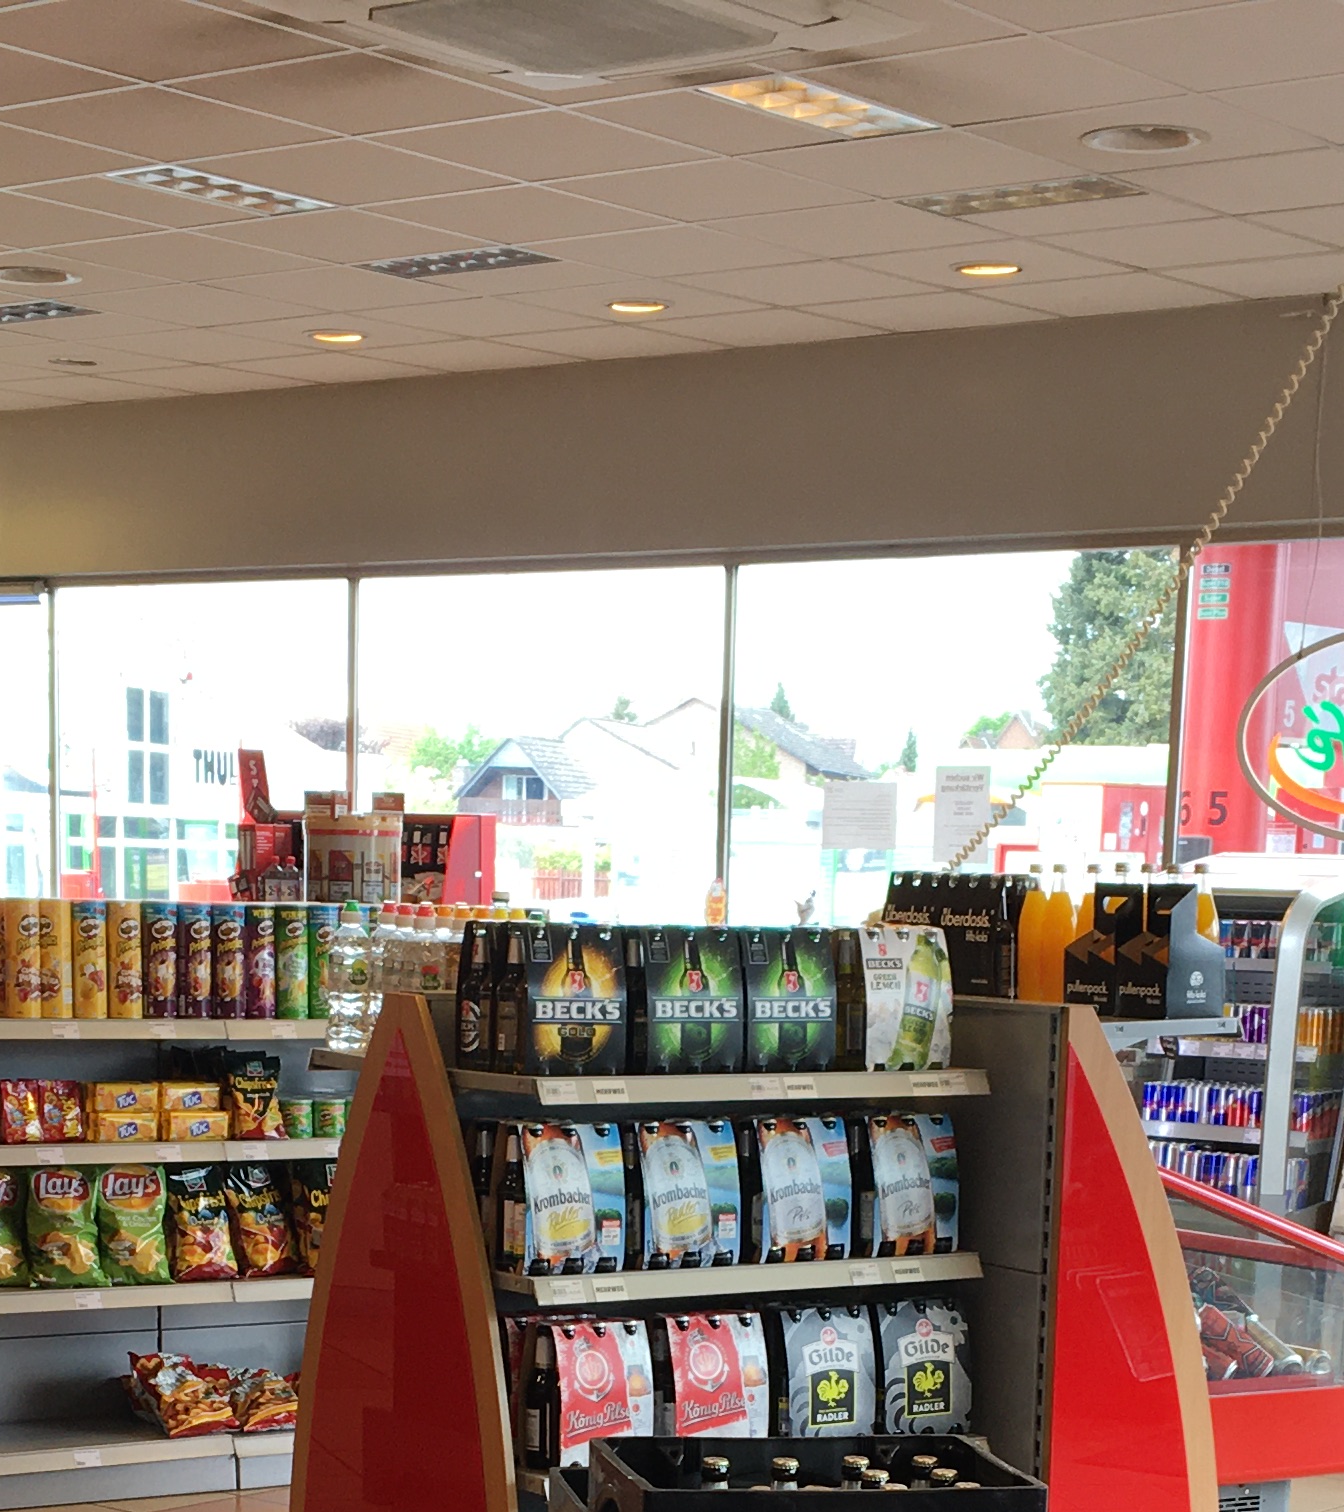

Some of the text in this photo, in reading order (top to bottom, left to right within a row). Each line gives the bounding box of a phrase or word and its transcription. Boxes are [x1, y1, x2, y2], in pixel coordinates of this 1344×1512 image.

[1208, 791, 1229, 826] 5
[868, 959, 902, 969] BECK'S
[535, 998, 620, 1019] BECK'S
[655, 998, 738, 1018] BECK'S
[755, 998, 832, 1018] BECK'S
[117, 1091, 137, 1109] TUC
[182, 1092, 202, 1109] TUC
[118, 1121, 138, 1139] TUC
[190, 1119, 210, 1137] TUC
[105, 1174, 157, 1197] Lay's
[770, 1178, 822, 1205] Krombacher
[882, 1174, 930, 1200] Krombacher
[534, 1187, 591, 1214] Krombacher
[652, 1183, 706, 1210] Krombacher
[808, 1349, 855, 1366] Gilde
[904, 1340, 950, 1357] Gilde
[682, 1398, 720, 1422] König
[816, 1411, 849, 1423] RADLER
[912, 1402, 946, 1414] RADLER
[566, 1410, 604, 1437] König
